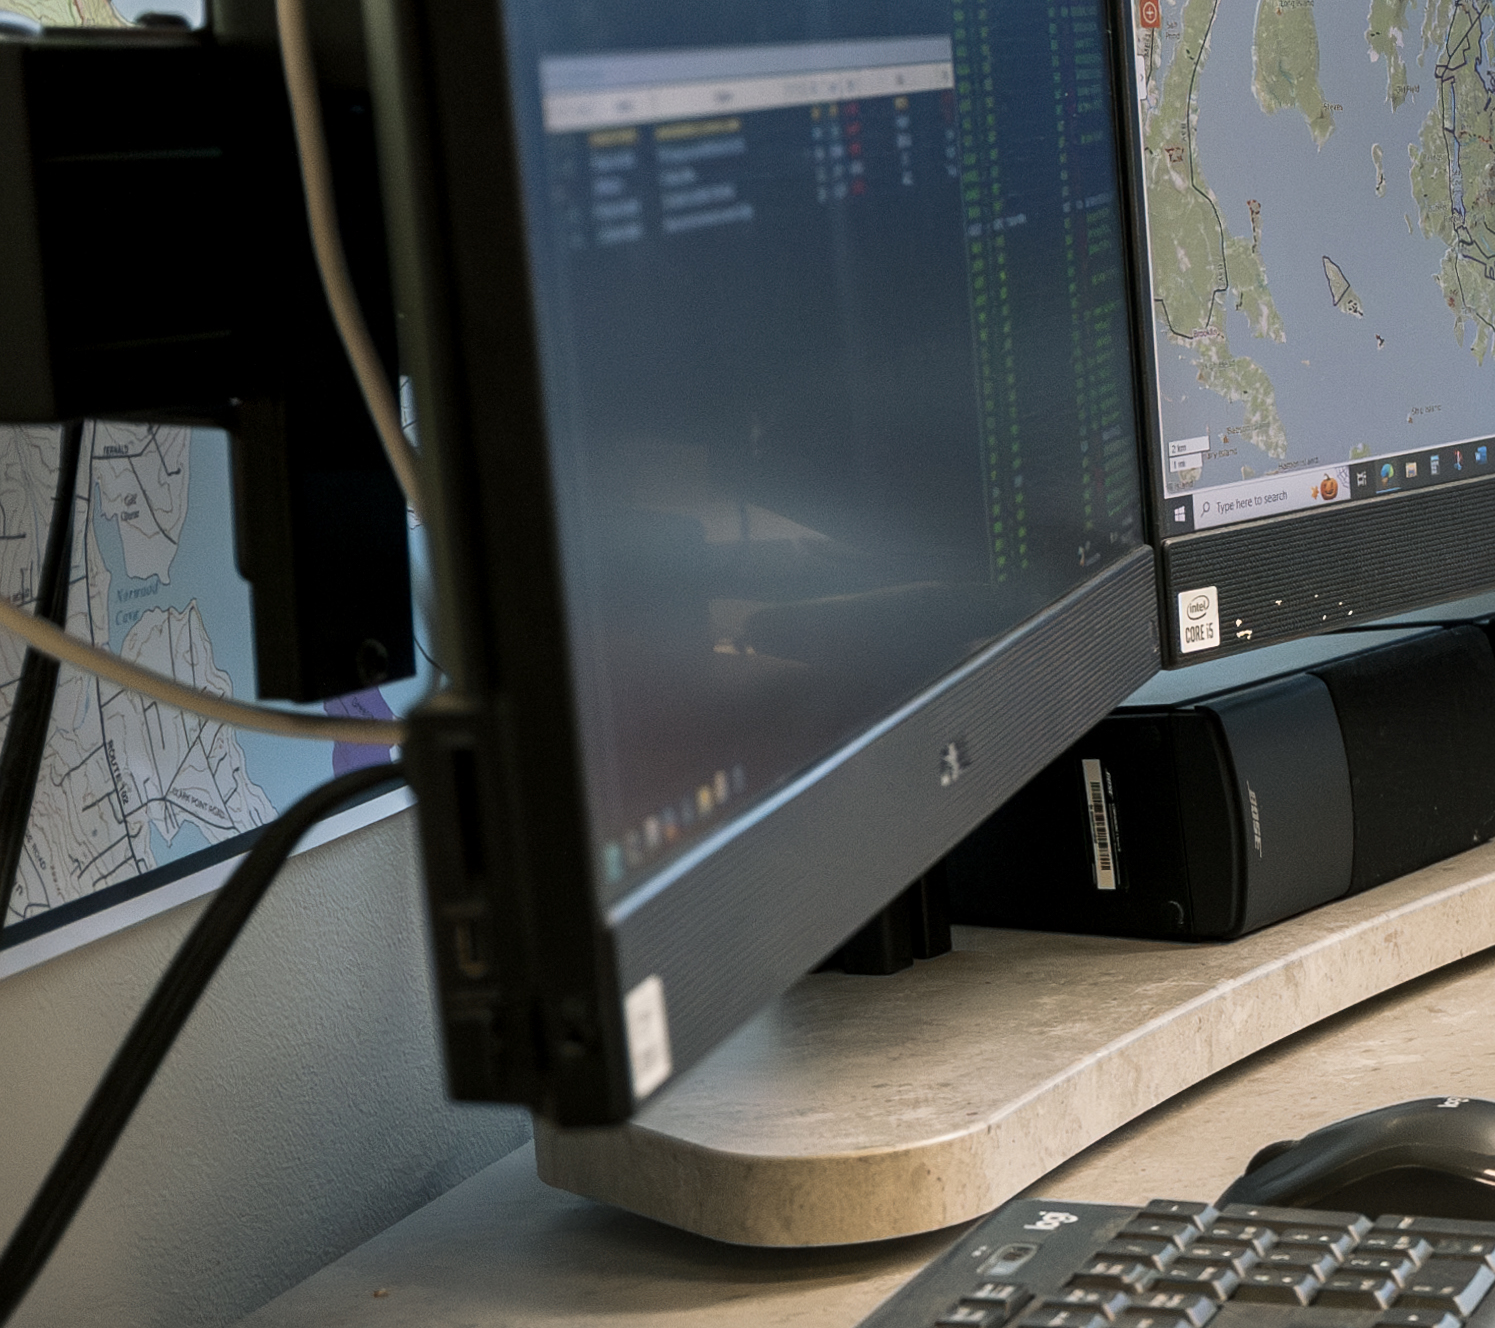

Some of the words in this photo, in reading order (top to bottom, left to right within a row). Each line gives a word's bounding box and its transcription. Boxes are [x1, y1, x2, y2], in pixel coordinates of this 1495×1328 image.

[1176, 443, 1187, 453] km
[1216, 500, 1235, 515] Type
[1235, 496, 1253, 510] here
[1253, 494, 1263, 506] to
[1263, 489, 1288, 505] search
[1188, 598, 1209, 615] intel
[1185, 625, 1205, 644] CORE
[1205, 622, 1214, 639] i5
[107, 739, 123, 783] ROUTE
[1247, 781, 1262, 857] BOSE
[1025, 1210, 1079, 1231] logi
